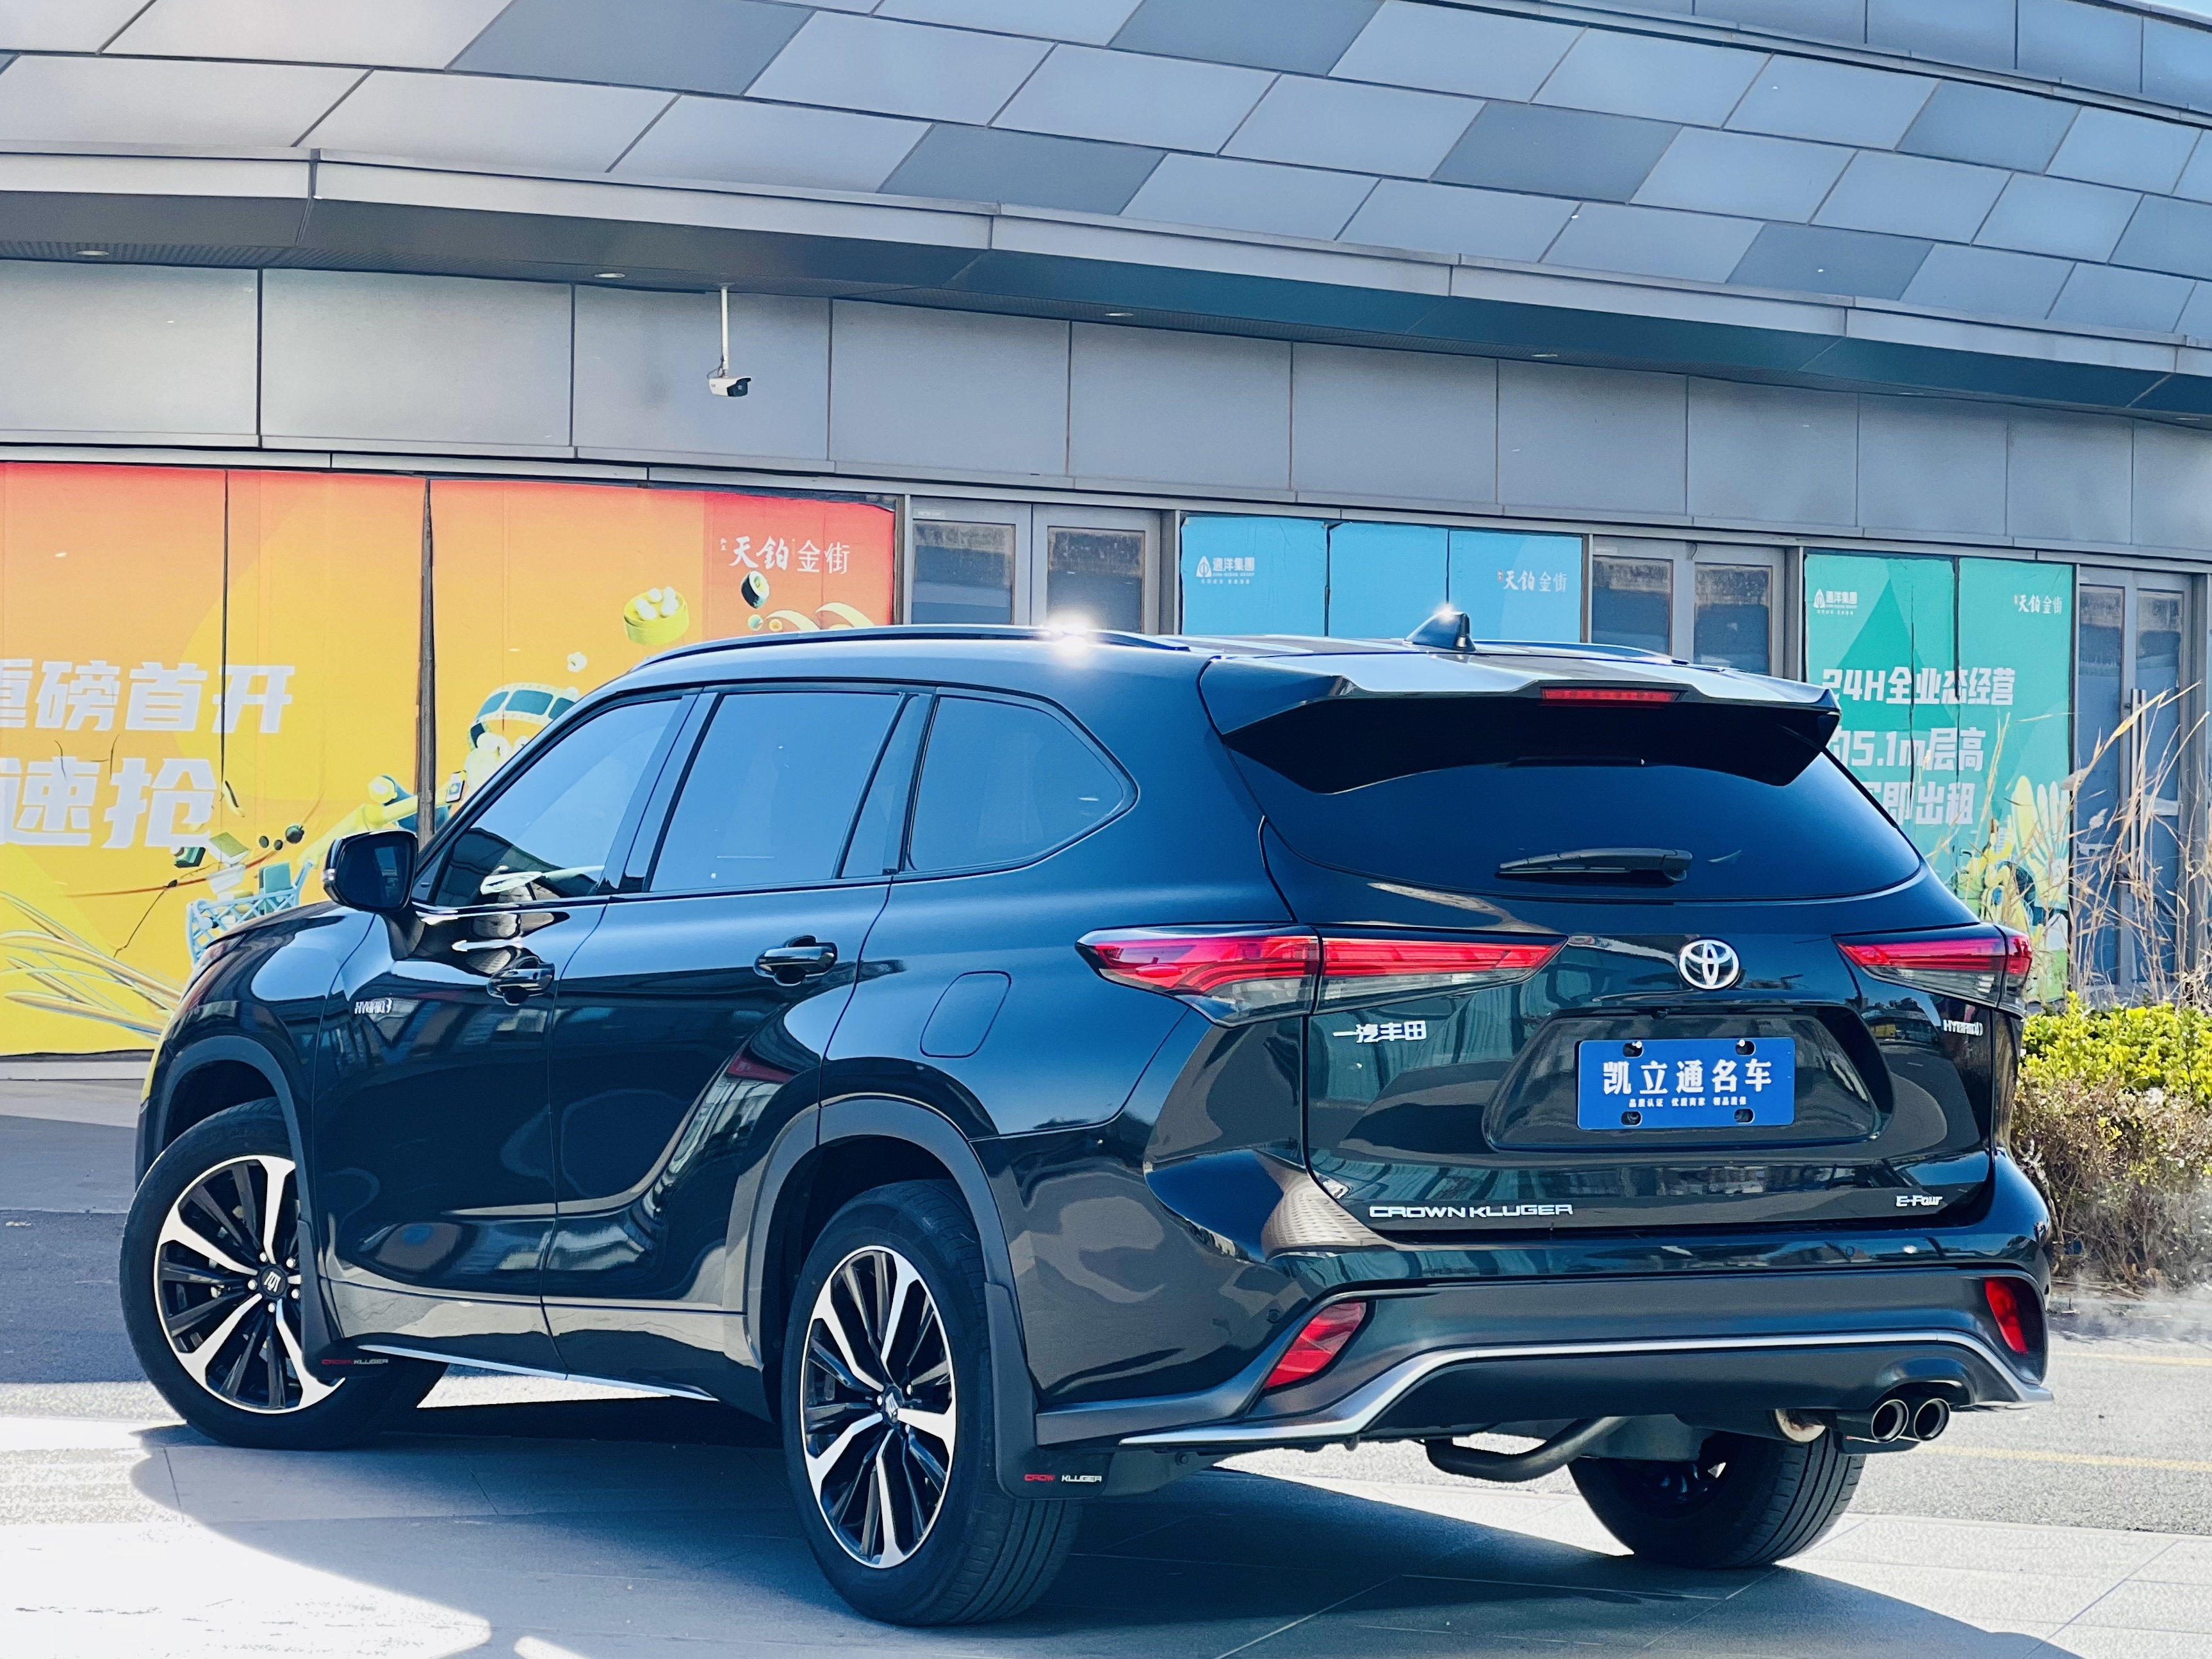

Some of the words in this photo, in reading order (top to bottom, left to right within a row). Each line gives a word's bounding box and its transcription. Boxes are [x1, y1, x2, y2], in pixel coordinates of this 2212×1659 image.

[1822, 666, 2016, 706] 24H全业态经营
[1332, 1020, 1427, 1043] 一汽丰田
[1603, 1058, 1772, 1095] 凯立通名车
[1369, 1205, 1466, 1218] CROWN
[1470, 1204, 1573, 1217] KLUGER
[1896, 1195, 1943, 1207] E-Four
